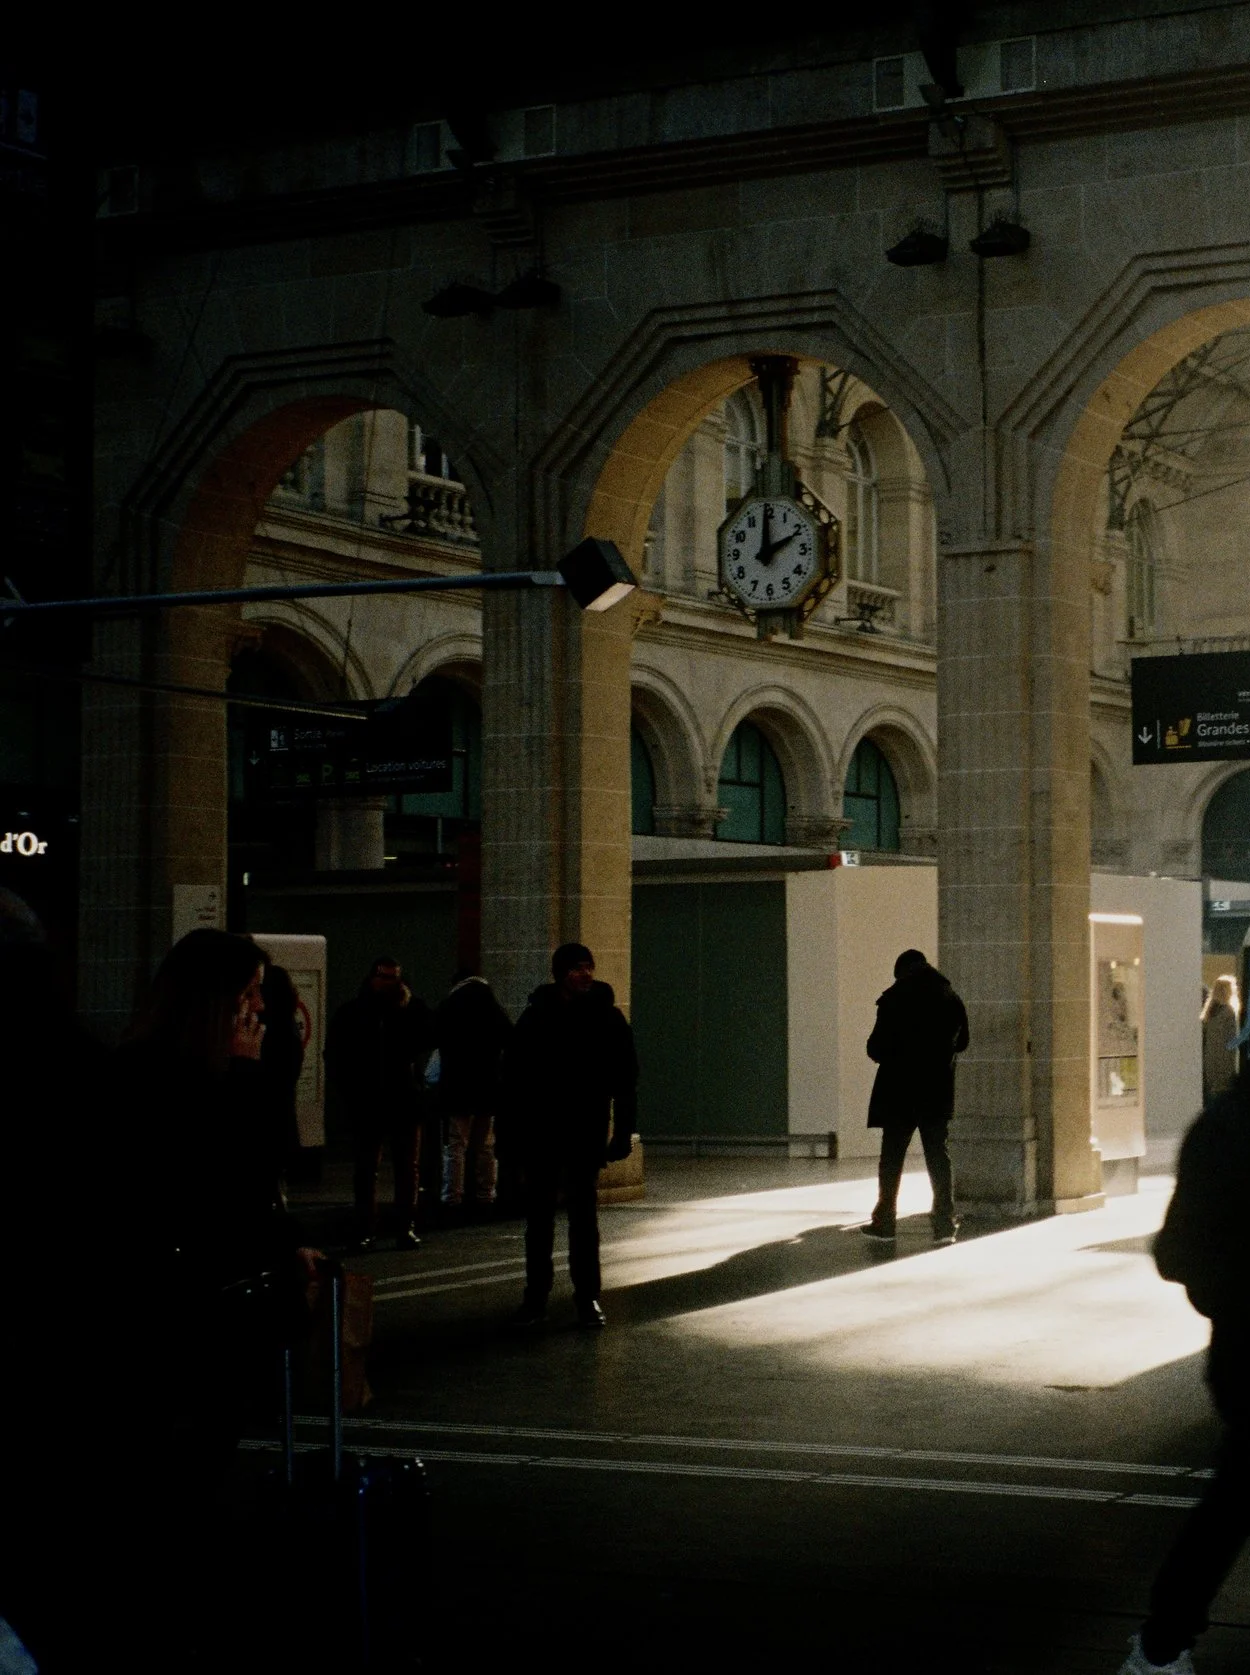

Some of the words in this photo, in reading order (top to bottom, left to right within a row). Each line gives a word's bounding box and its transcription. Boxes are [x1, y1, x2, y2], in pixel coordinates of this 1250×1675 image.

[1196, 711, 1240, 722] Billetterie
[1197, 722, 1250, 737] Grandes
[365, 760, 406, 774] Location
[408, 758, 448, 770] voitures
[0, 831, 49, 857] d'Or
